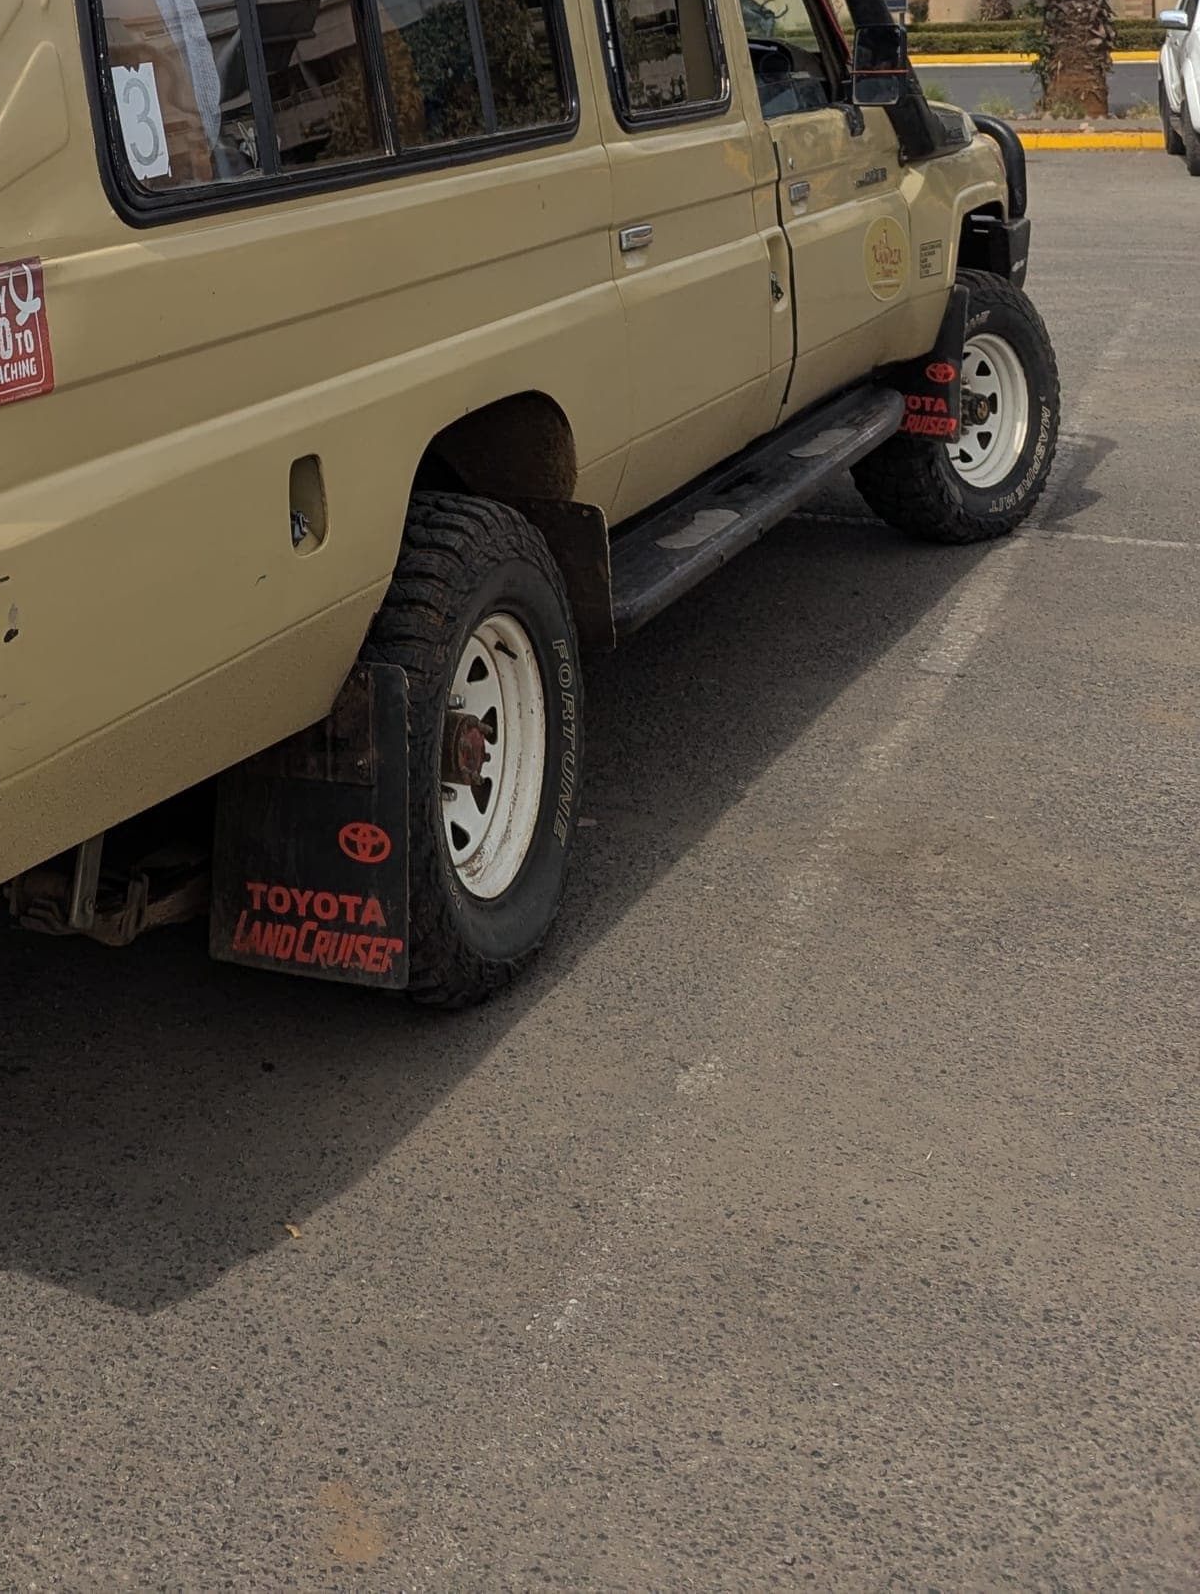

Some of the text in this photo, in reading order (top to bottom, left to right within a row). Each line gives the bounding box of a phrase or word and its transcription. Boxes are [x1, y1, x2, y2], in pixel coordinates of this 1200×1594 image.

[122, 77, 160, 166] 3
[15, 330, 34, 355] TO
[904, 394, 948, 413] OTA
[552, 638, 577, 847] FORTUNE
[246, 882, 387, 927] TOYOTA
